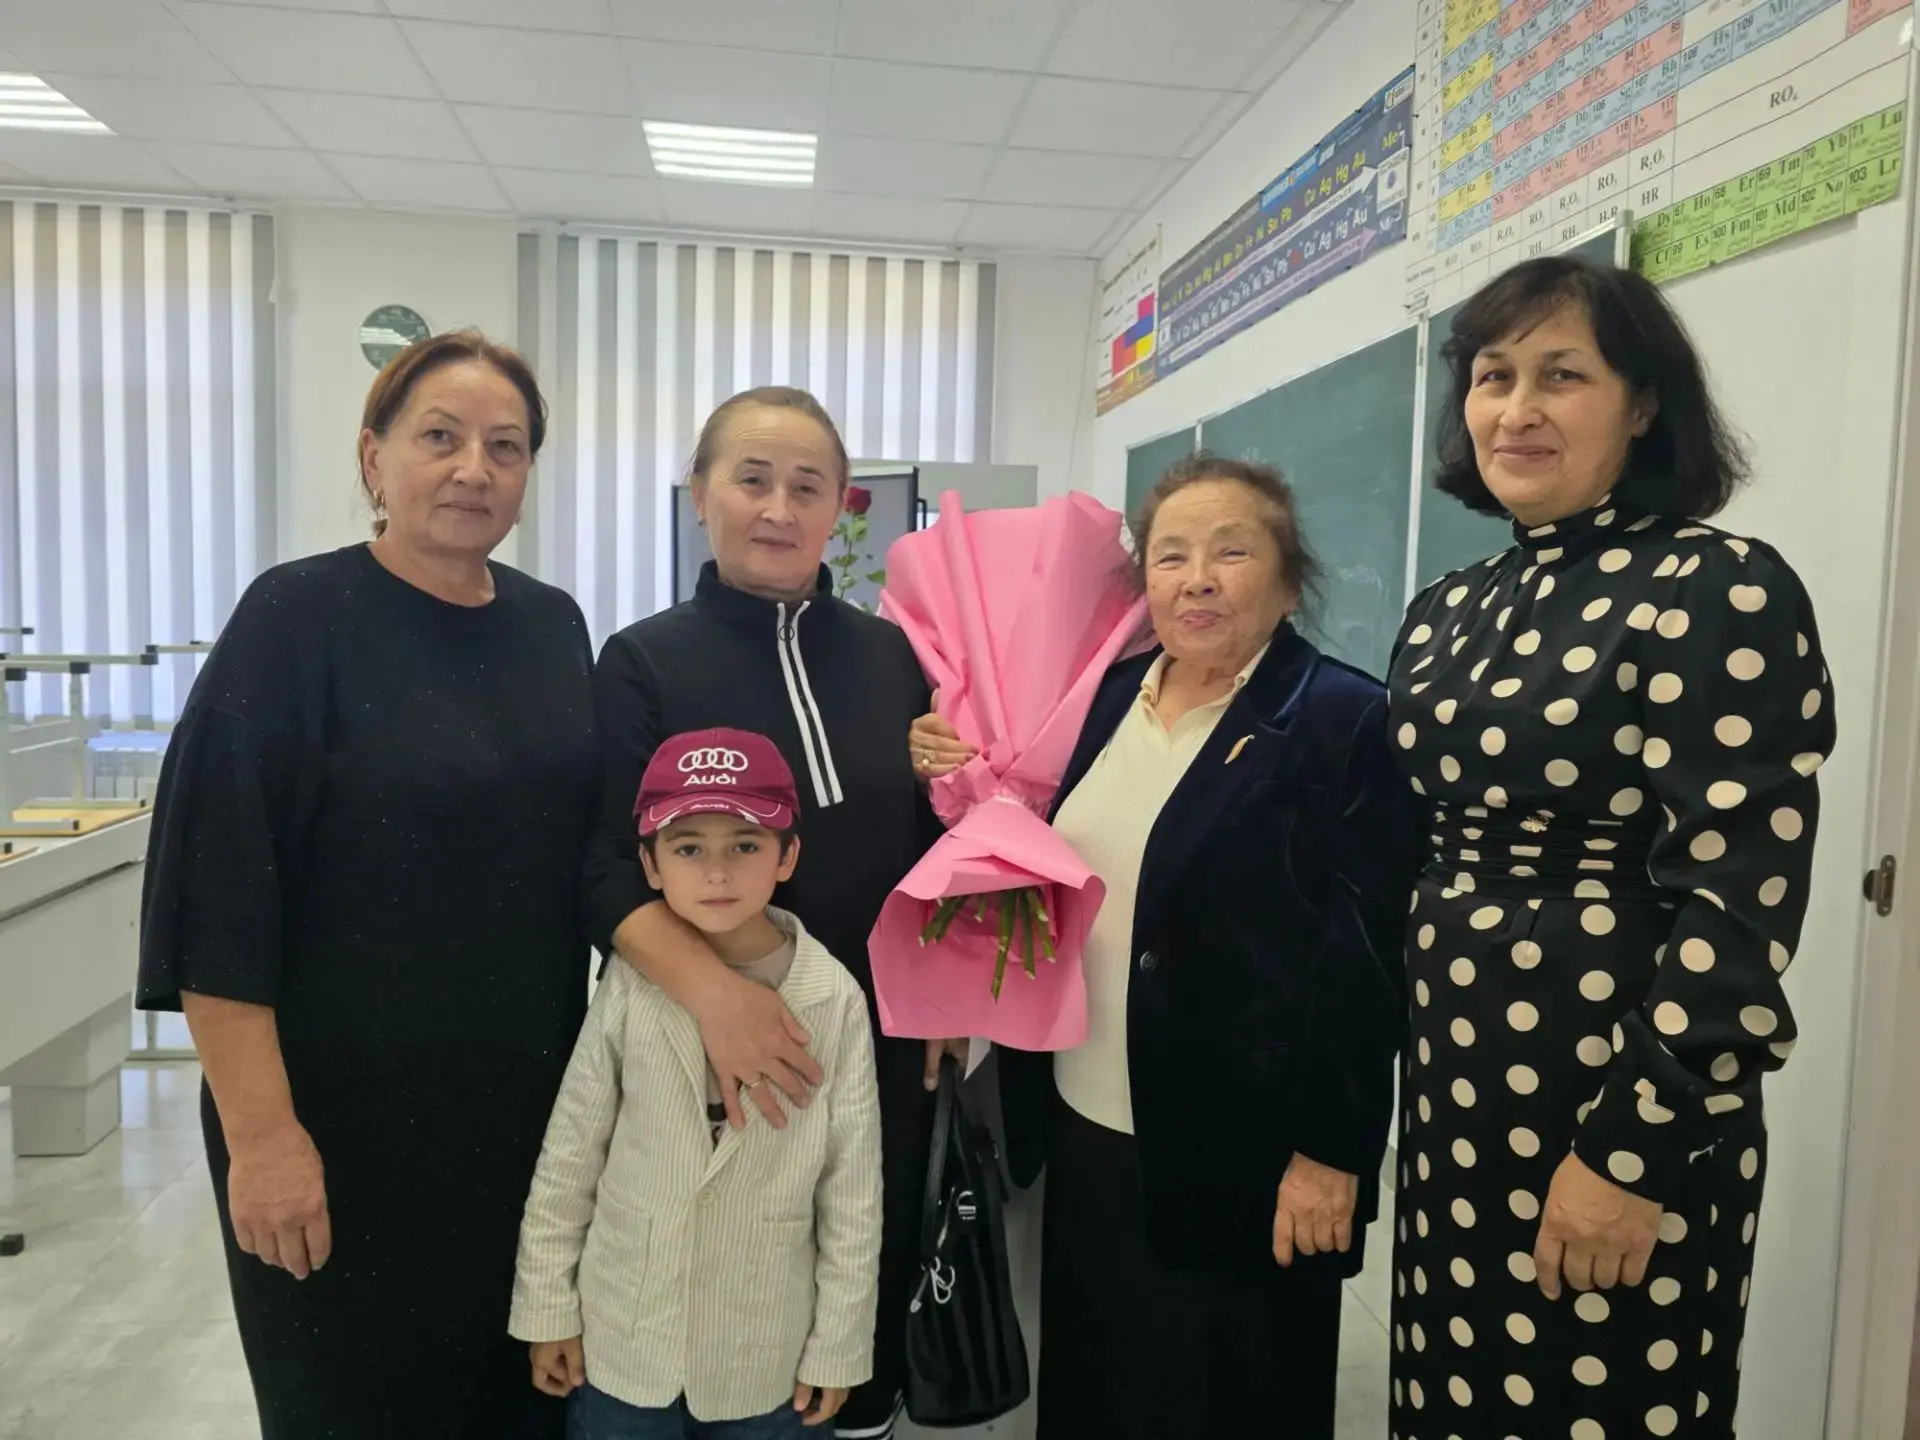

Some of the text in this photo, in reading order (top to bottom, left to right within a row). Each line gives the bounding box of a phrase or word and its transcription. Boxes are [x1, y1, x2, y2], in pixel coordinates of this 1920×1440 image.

[1880, 108, 1903, 130] Lu
[1828, 126, 1848, 152] Yb
[1758, 154, 1801, 181] 69 Tm
[1848, 156, 1900, 184] 103 Lr
[1738, 174, 1756, 194] Er
[1800, 188, 1818, 205] 102
[1825, 178, 1844, 196] No
[1641, 187, 1660, 207] HR
[1694, 196, 1712, 212] Ho
[1775, 197, 1797, 218] Md
[1352, 208, 1368, 228] Au
[1730, 216, 1751, 236] Fm
[1694, 234, 1710, 252] Es
